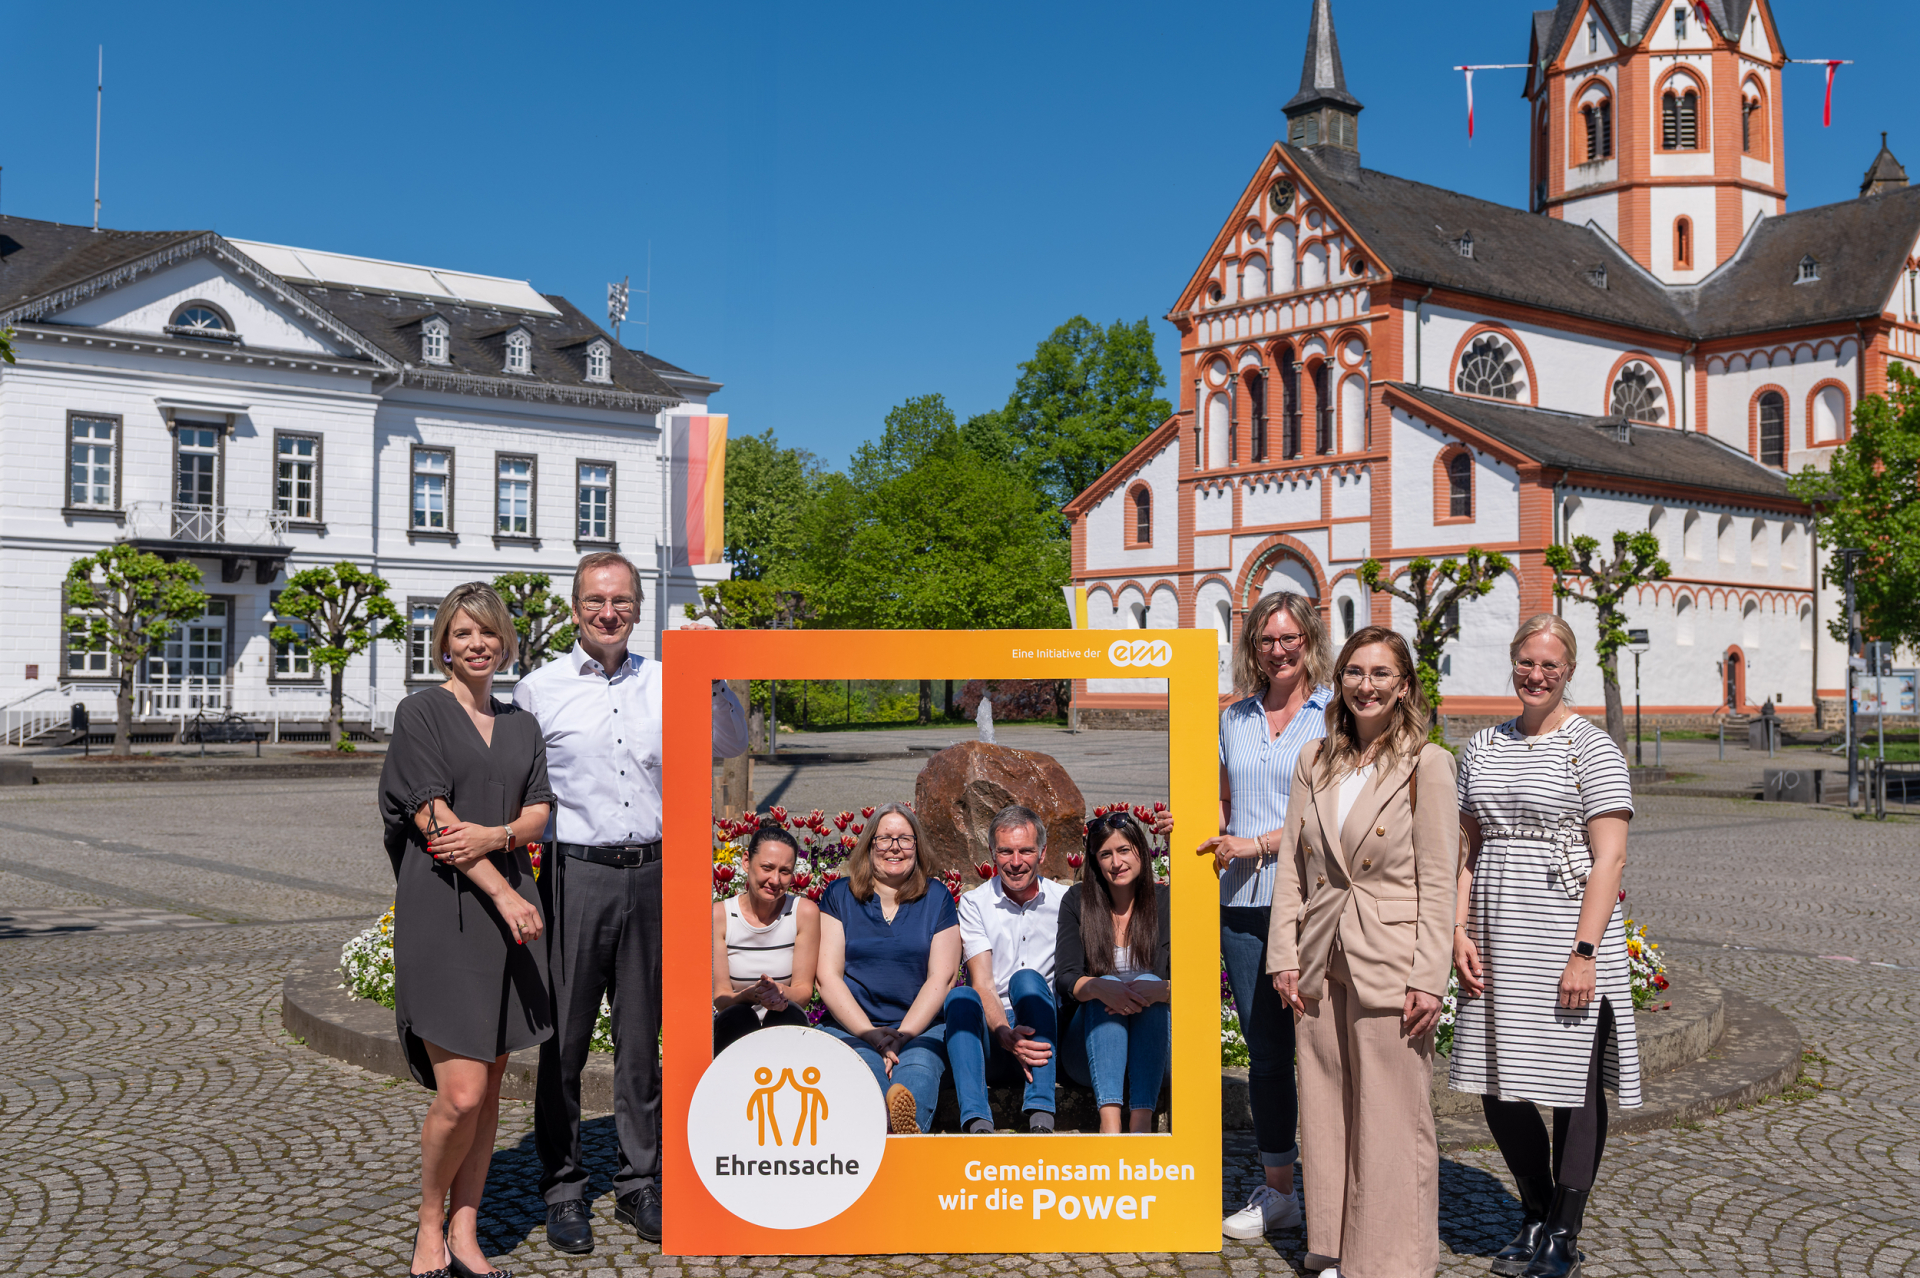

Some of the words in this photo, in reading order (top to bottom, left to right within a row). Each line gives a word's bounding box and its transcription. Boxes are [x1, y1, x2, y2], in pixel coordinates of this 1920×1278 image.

[1012, 648, 1035, 659] Eine
[1036, 648, 1081, 659] Initiative
[1083, 647, 1102, 659] der
[1112, 644, 1168, 663] evm
[1770, 770, 1800, 790] 10
[715, 1153, 860, 1177] Ehrensache
[964, 1158, 1111, 1182] Gemeinsam
[1118, 1158, 1195, 1181] haben
[937, 1188, 979, 1211] wir
[985, 1187, 1024, 1211] die
[1032, 1188, 1157, 1221] Power
